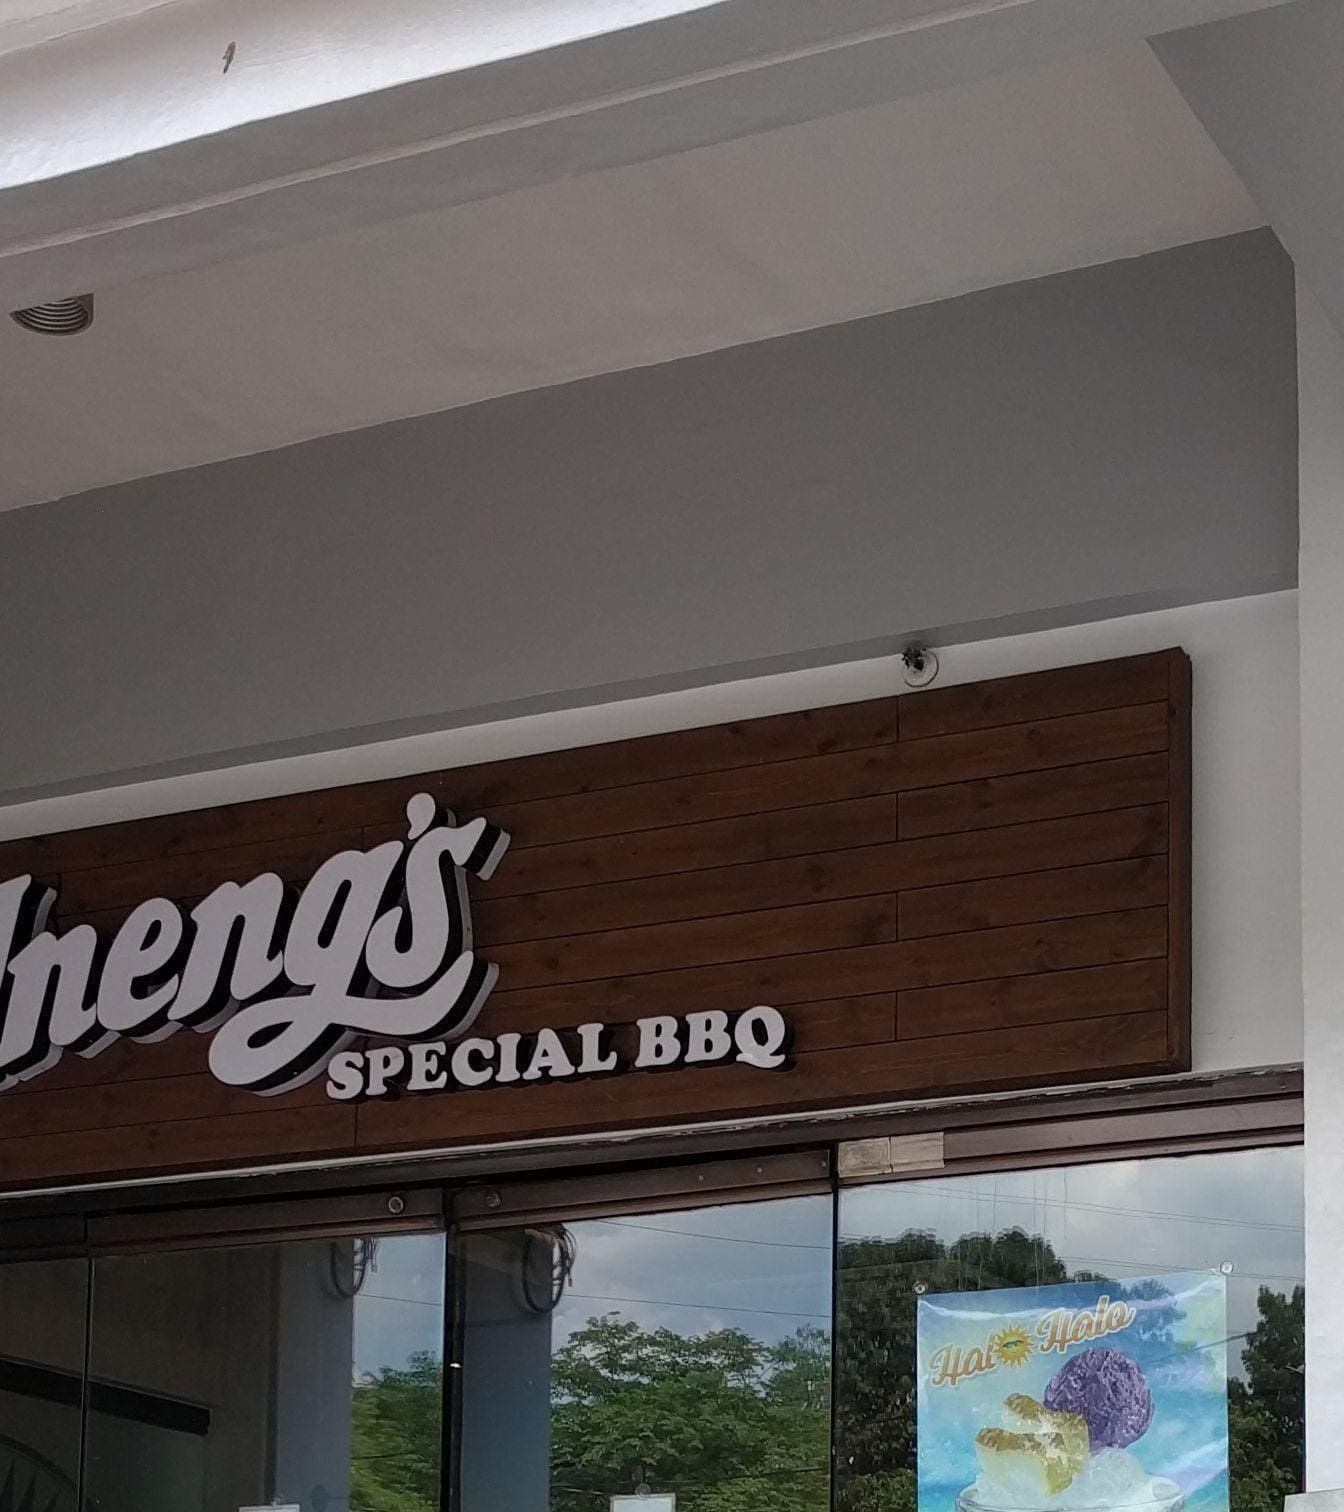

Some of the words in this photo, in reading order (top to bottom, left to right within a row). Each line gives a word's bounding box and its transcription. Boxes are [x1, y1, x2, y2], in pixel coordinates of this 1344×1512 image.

[325, 1020, 619, 1102] SPECIAL
[633, 1004, 790, 1070] BBQ
[1035, 1295, 1136, 1354] Halo
